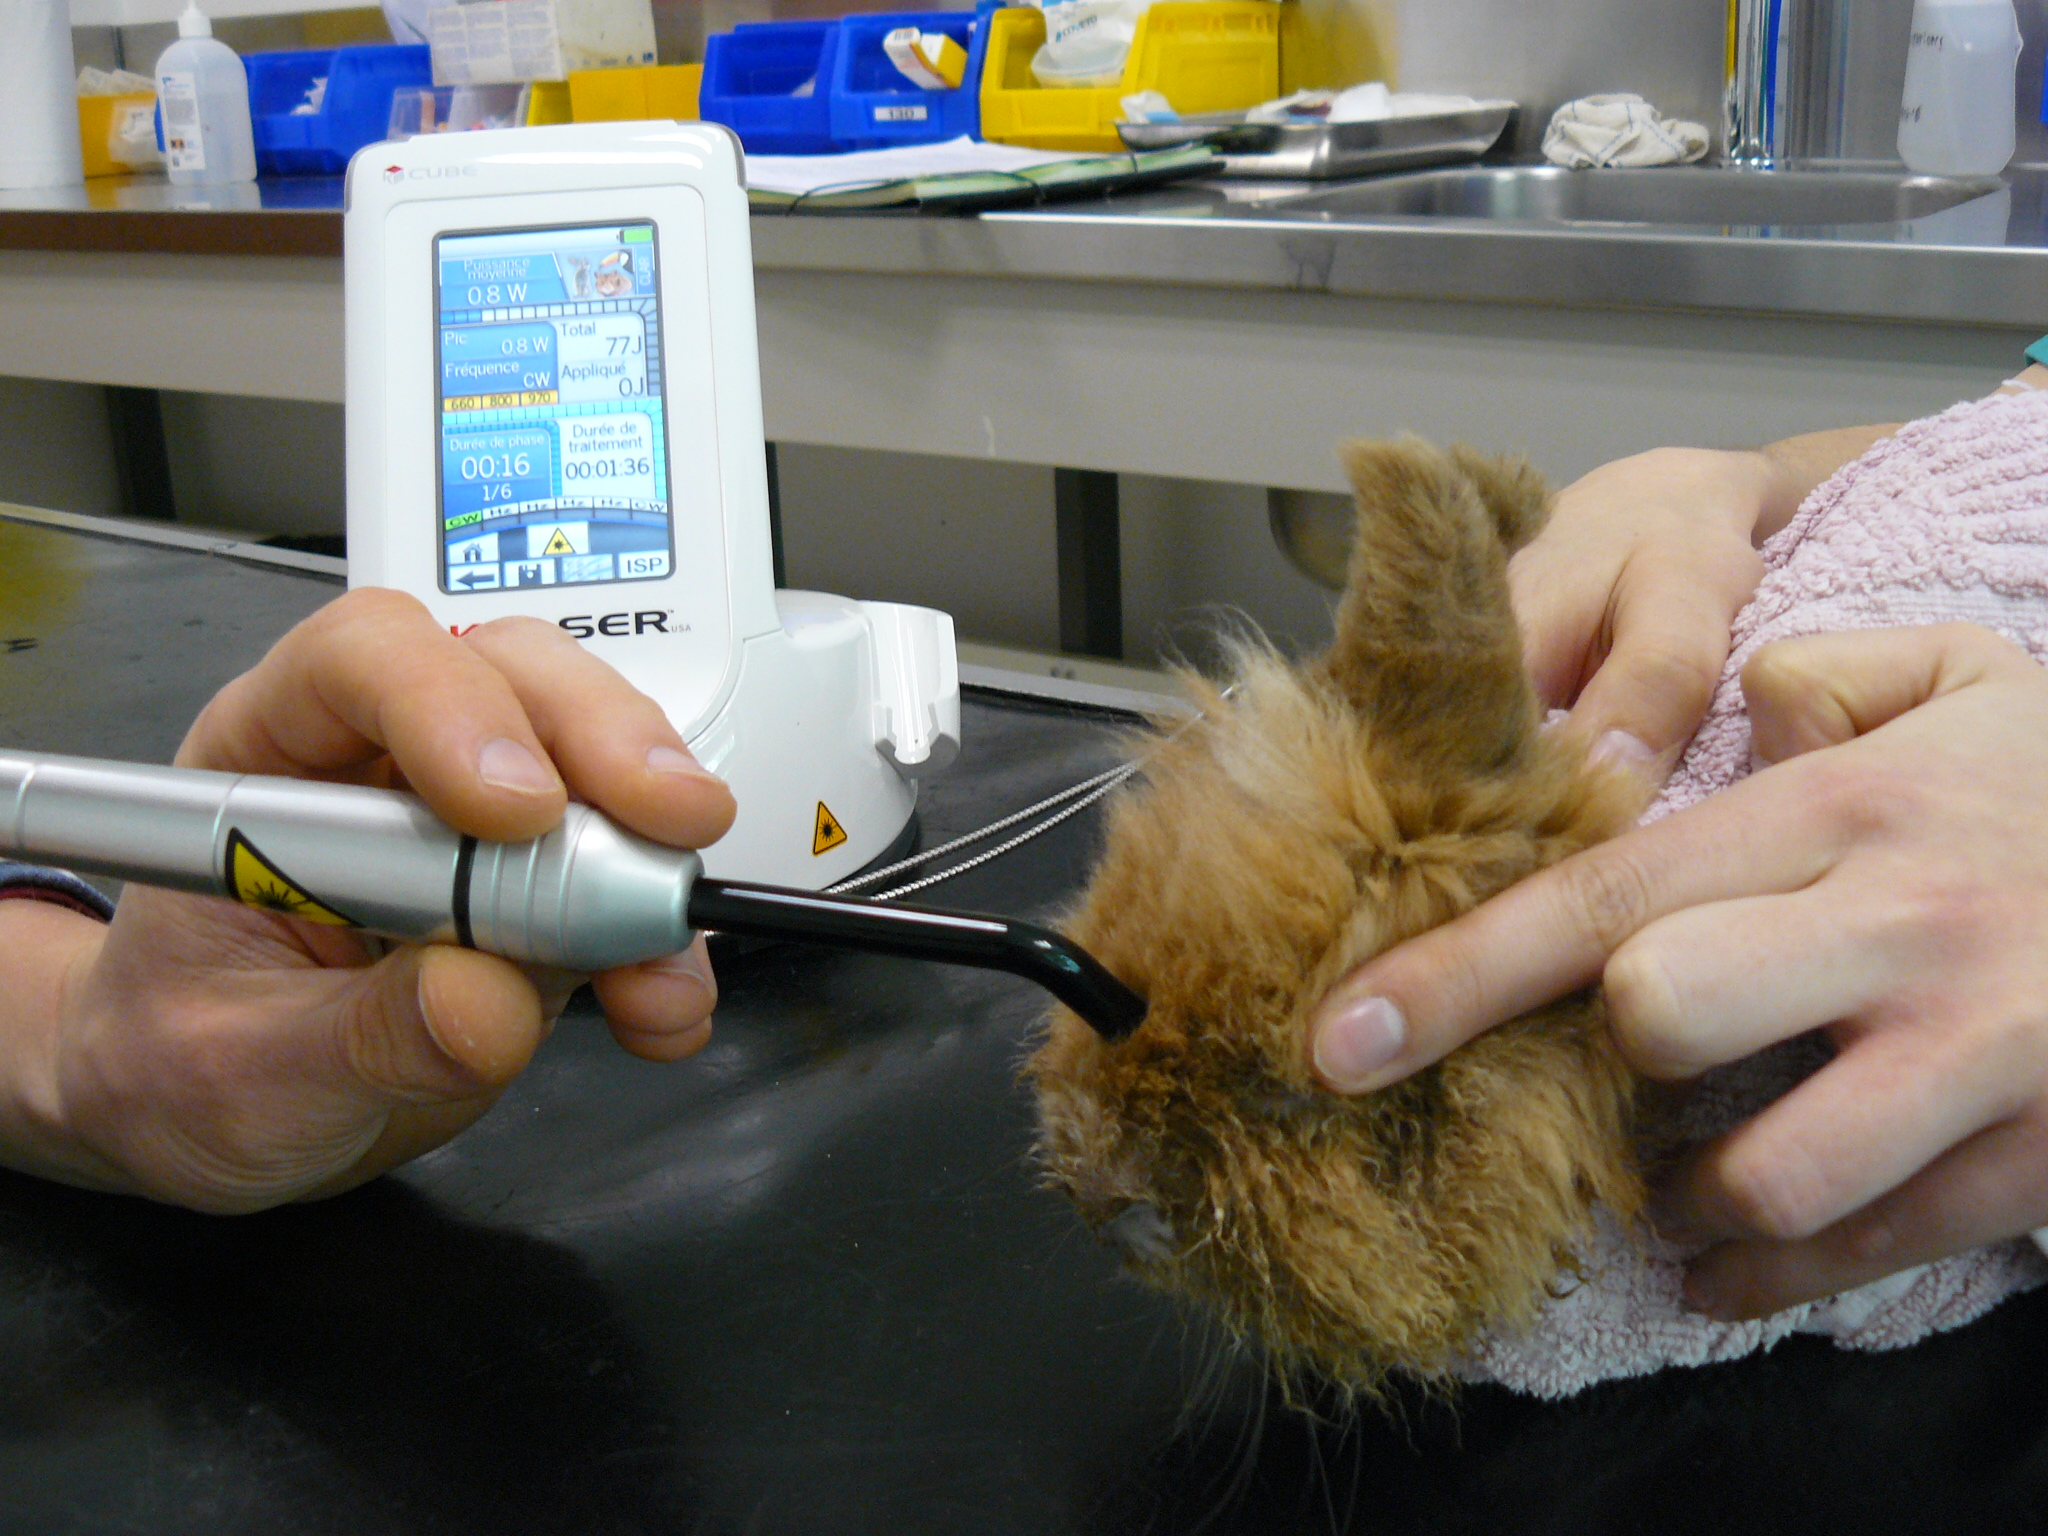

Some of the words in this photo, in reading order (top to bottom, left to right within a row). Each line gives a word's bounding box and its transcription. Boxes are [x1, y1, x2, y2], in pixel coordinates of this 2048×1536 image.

[408, 164, 478, 180] CUBE
[464, 257, 530, 272] Puissance
[468, 268, 526, 282] moyenne
[468, 285, 500, 305] 0.8
[507, 282, 527, 303] W
[560, 322, 596, 336] Total
[445, 331, 468, 345] Pic
[501, 337, 527, 355] 0.8
[533, 335, 549, 352] W
[445, 361, 519, 379] Fréquence
[561, 361, 626, 382] Appliqué
[523, 372, 550, 388] CW
[451, 397, 475, 409] 660
[489, 394, 513, 407] 800
[528, 391, 551, 404] 970
[573, 424, 615, 438] Durée
[620, 421, 637, 435] de
[450, 438, 486, 452] Durée
[490, 436, 505, 449] de
[508, 434, 544, 449] phase
[569, 436, 643, 453] traitement
[461, 453, 530, 480] 00:16
[565, 457, 650, 480] 00:01:36
[483, 483, 512, 501] 1/6
[450, 513, 478, 527] CW
[627, 557, 662, 573] ISP
[671, 623, 691, 633] USA
